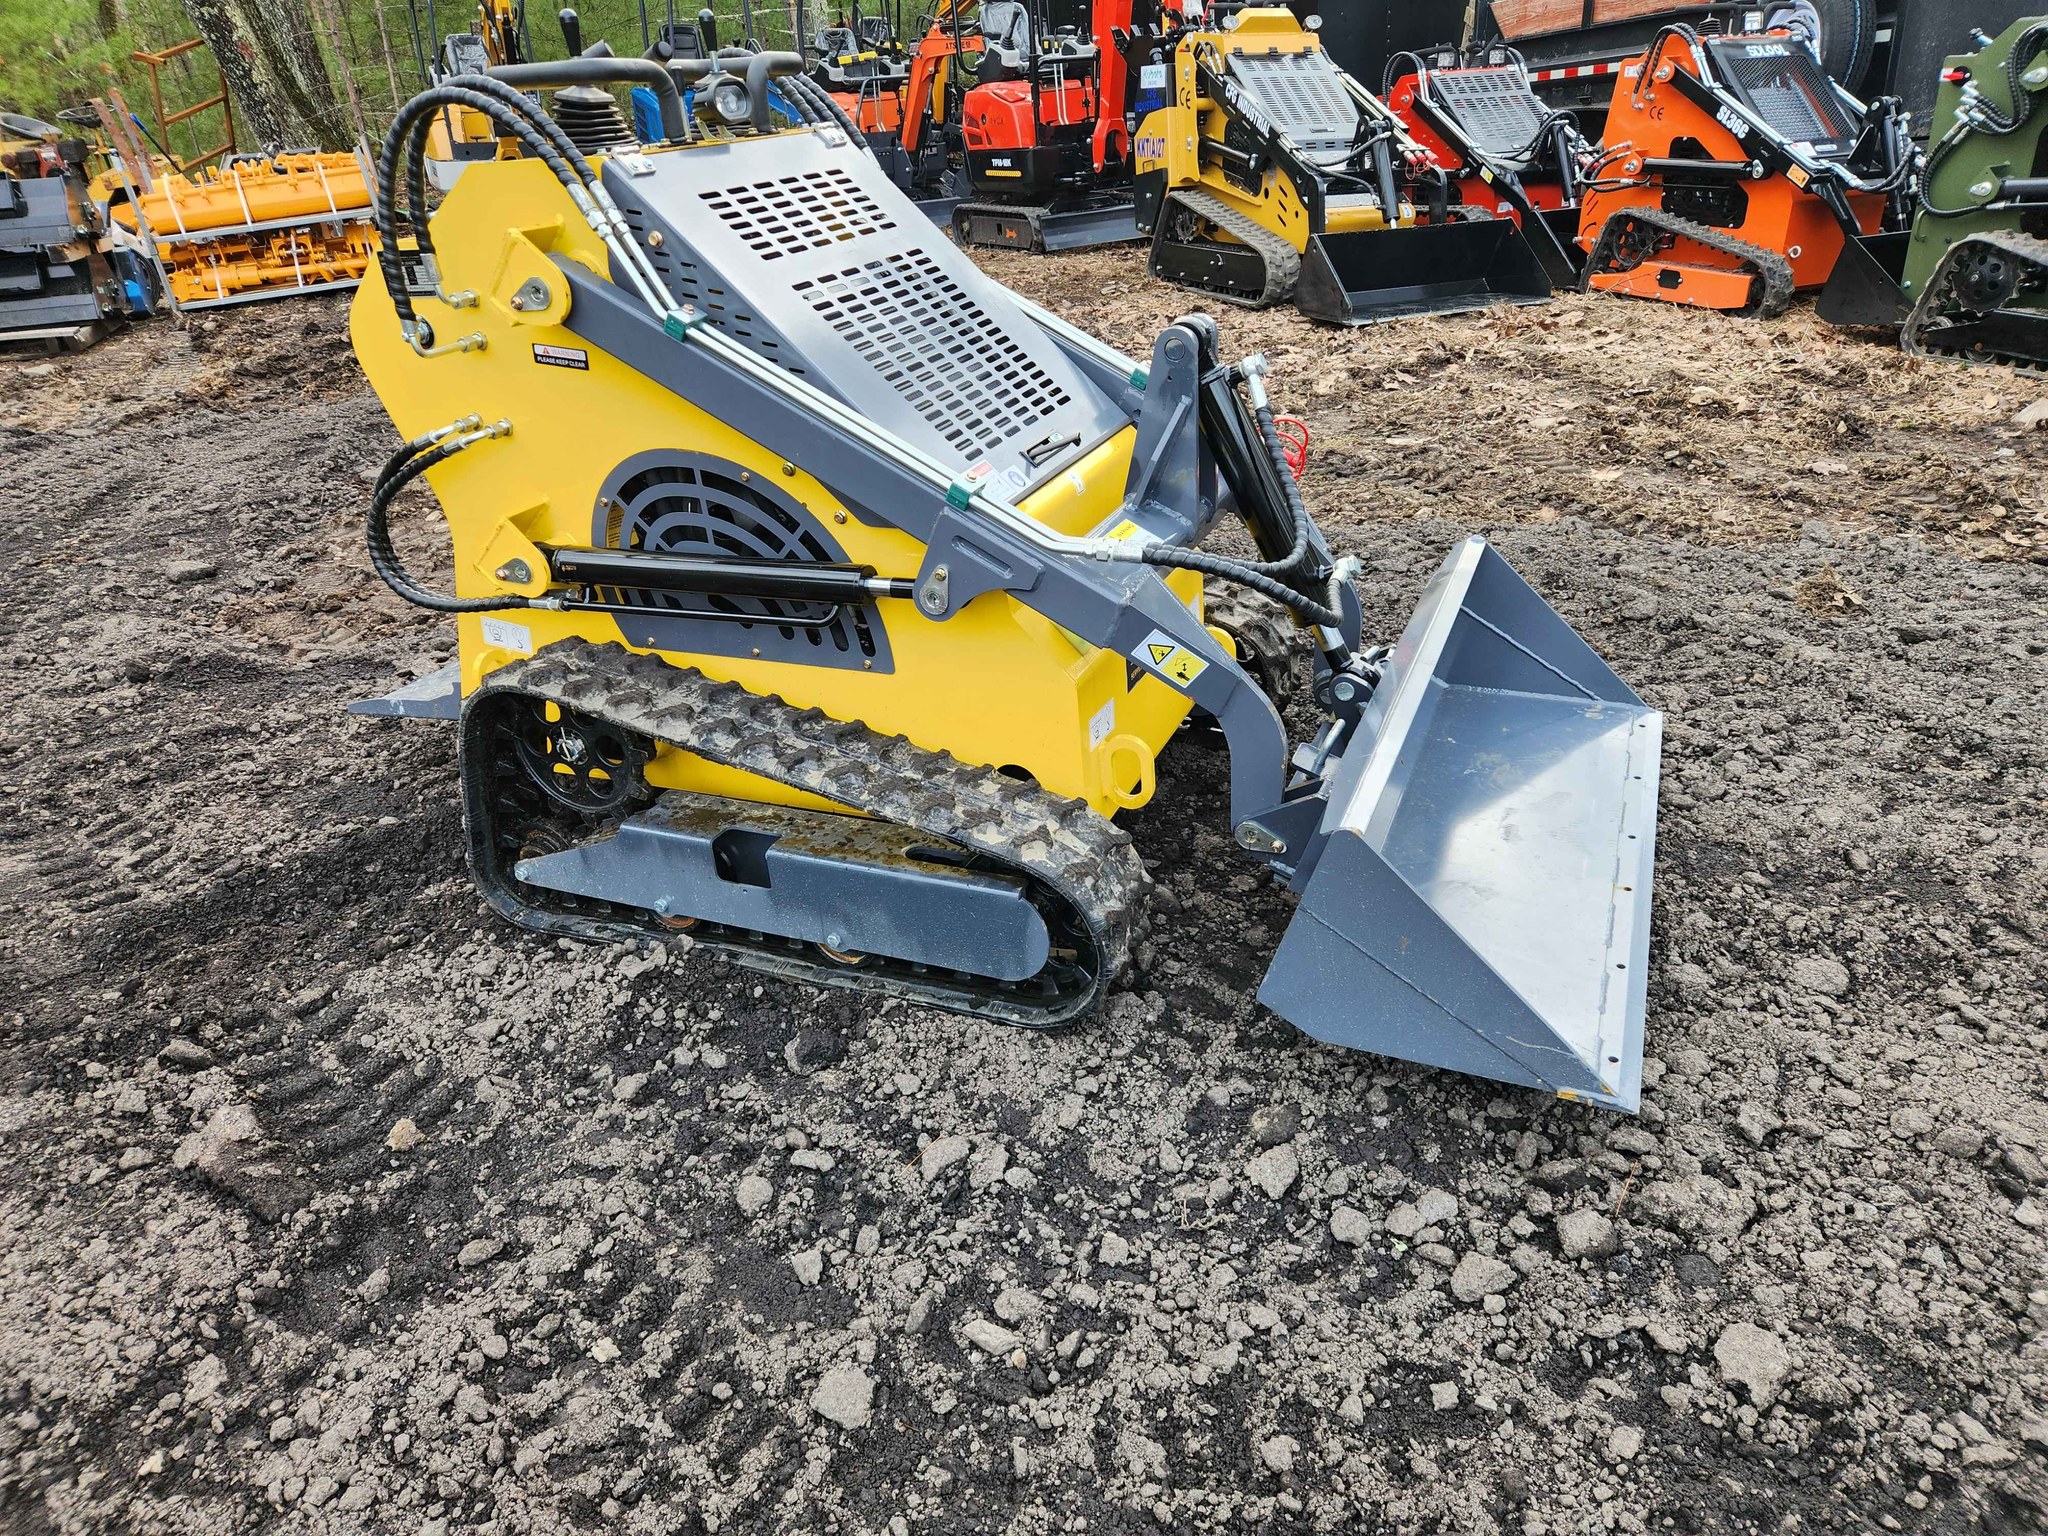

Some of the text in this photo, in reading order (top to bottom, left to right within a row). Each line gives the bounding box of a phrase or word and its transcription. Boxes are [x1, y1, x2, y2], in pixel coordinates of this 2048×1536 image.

[1225, 83, 1270, 139] CFG INDUSTRIAL
[1716, 105, 1750, 139] SL36C
[537, 355, 586, 368] PLEASE KEEP CLEAR
[551, 349, 580, 358] WARNING
